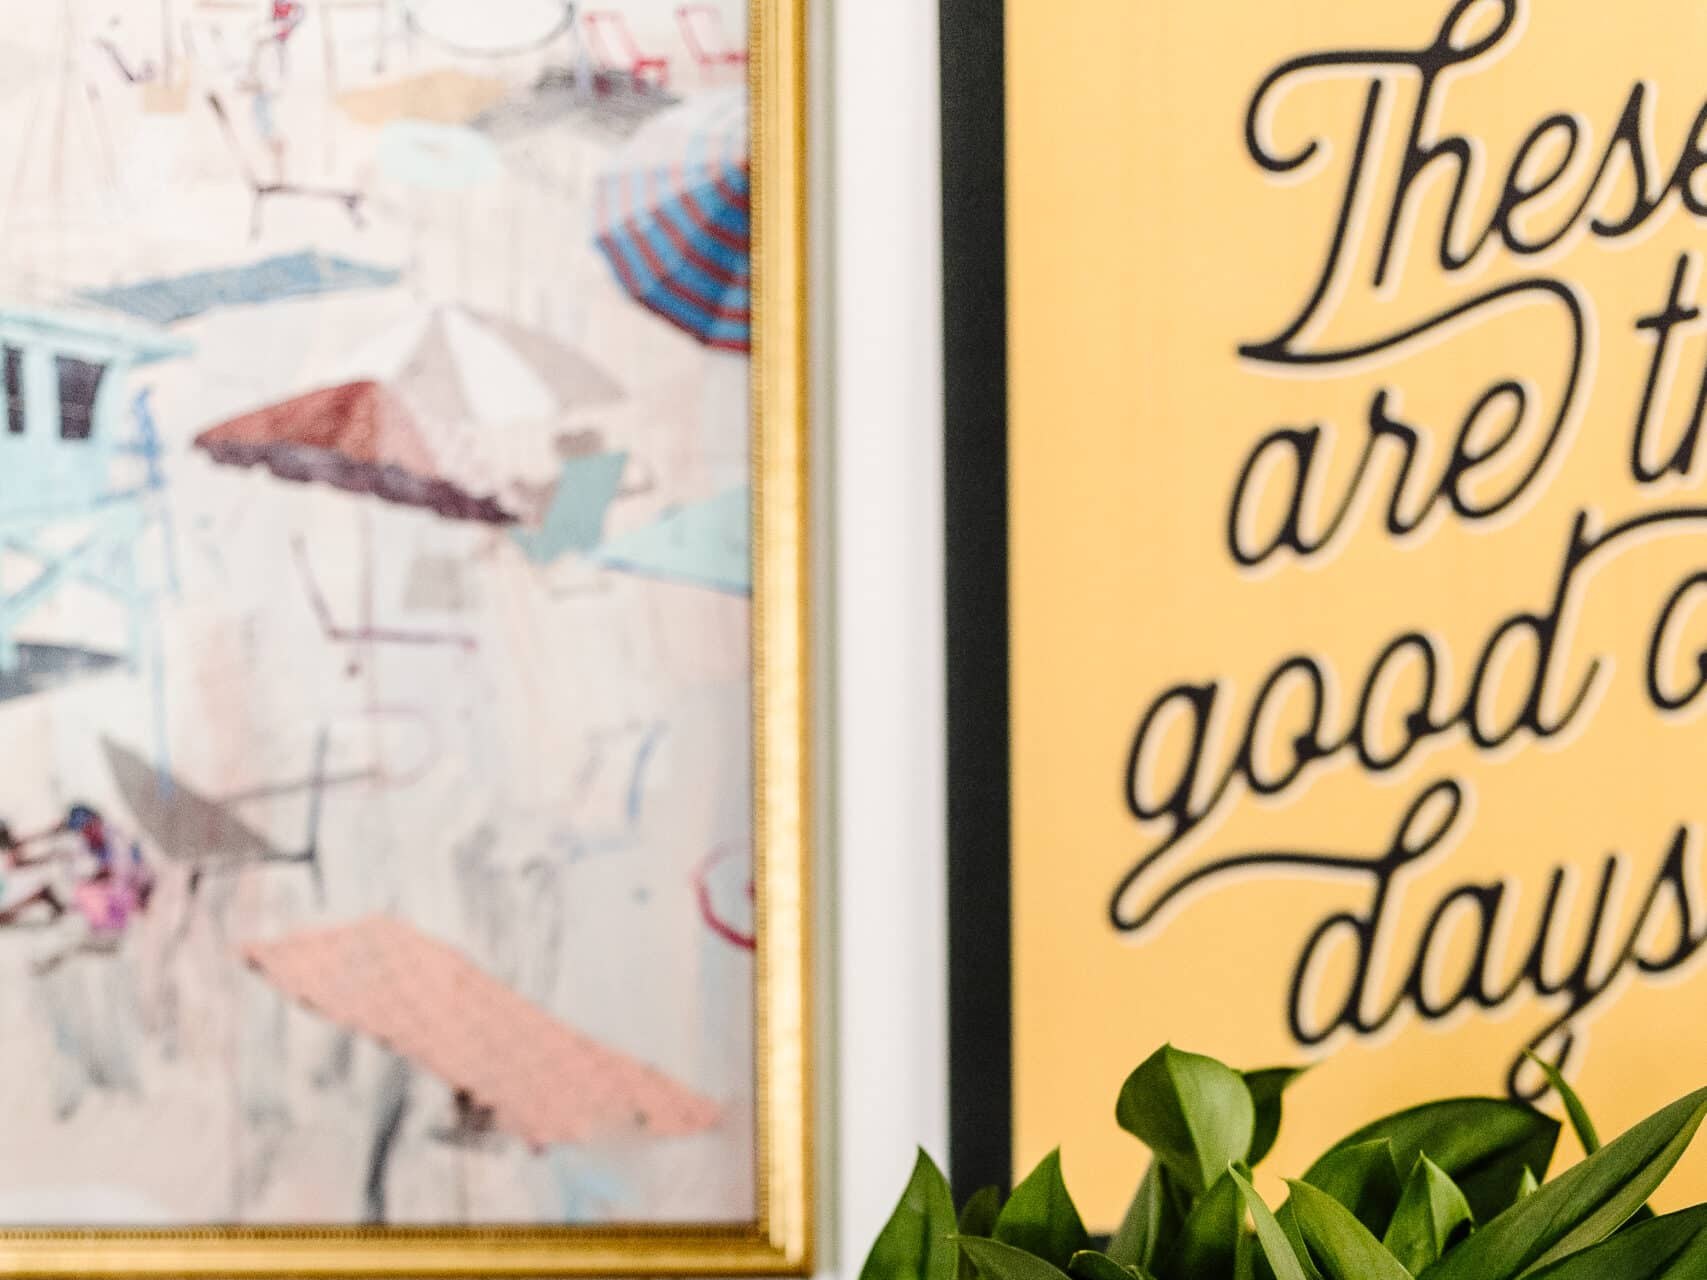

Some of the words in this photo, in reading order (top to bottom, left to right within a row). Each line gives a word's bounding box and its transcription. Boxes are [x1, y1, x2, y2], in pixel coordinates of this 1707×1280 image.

[1229, 380, 1584, 567] are
[1110, 510, 1600, 931] good
[1288, 779, 1707, 1102] days
